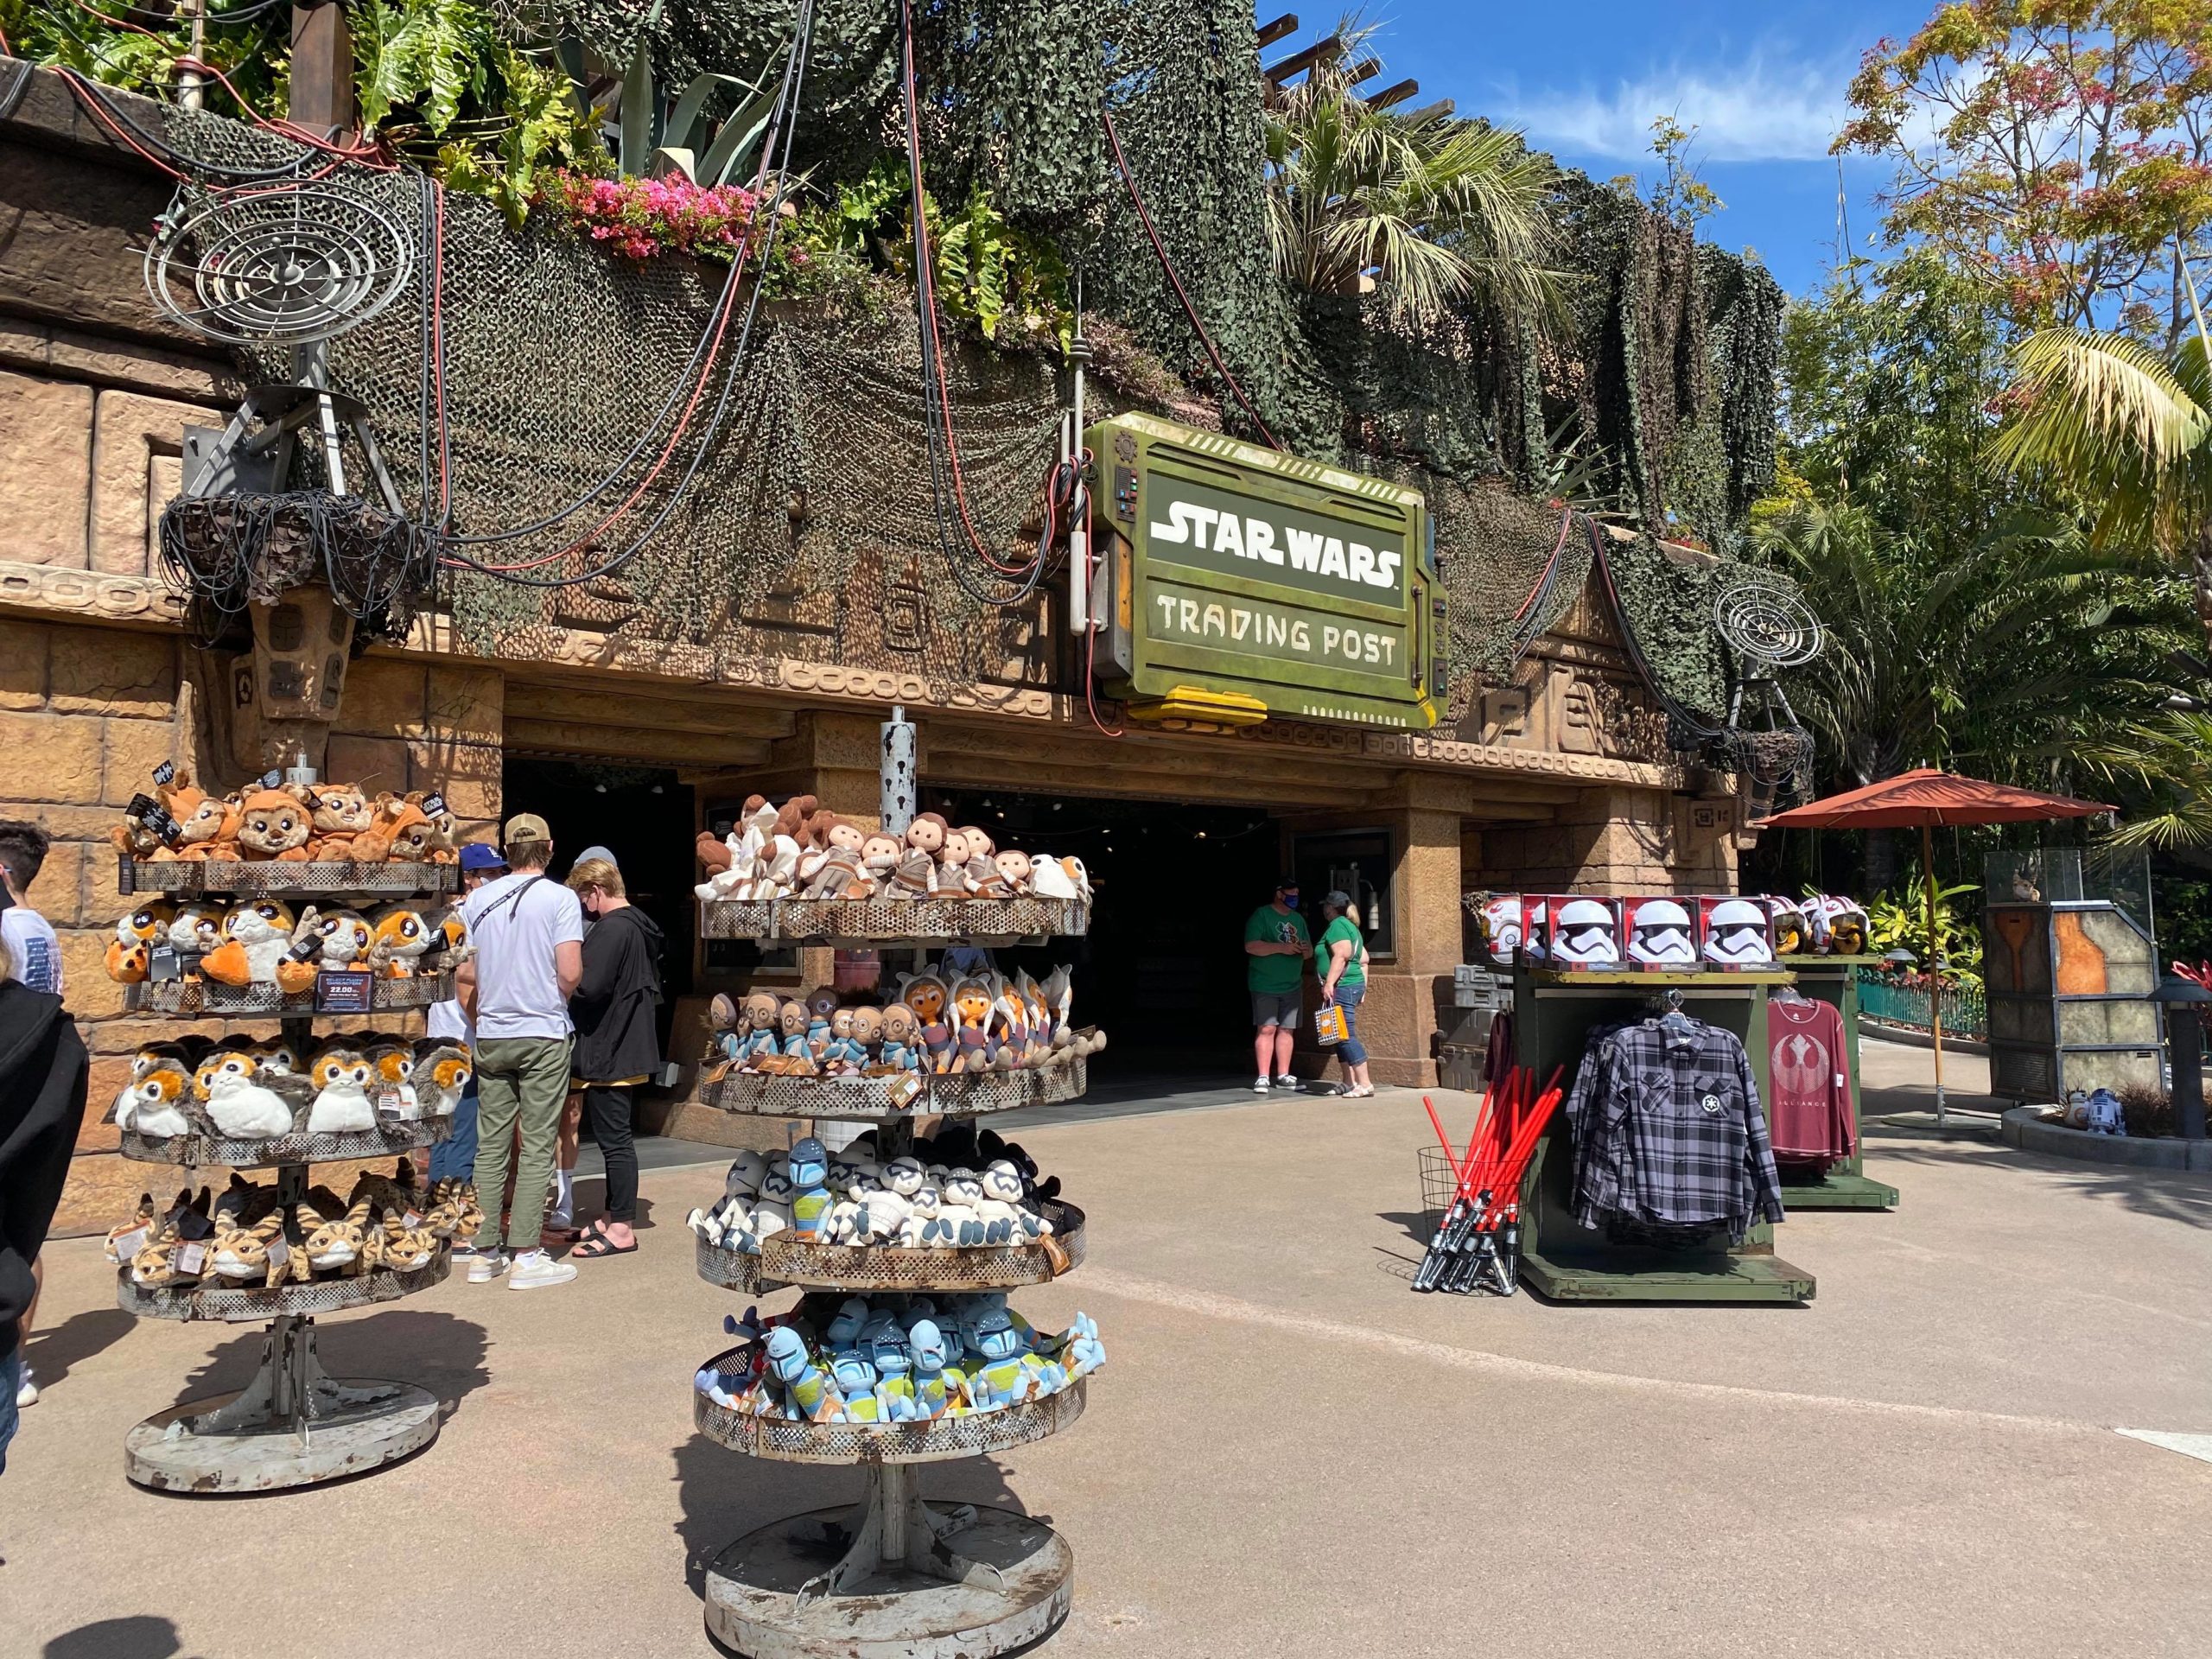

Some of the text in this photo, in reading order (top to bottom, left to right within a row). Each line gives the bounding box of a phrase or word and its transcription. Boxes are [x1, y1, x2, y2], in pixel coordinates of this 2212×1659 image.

[1150, 500, 1401, 588] STAR WARS
[1157, 594, 1396, 666] TRADING POST
[488, 896, 507, 911] adidas
